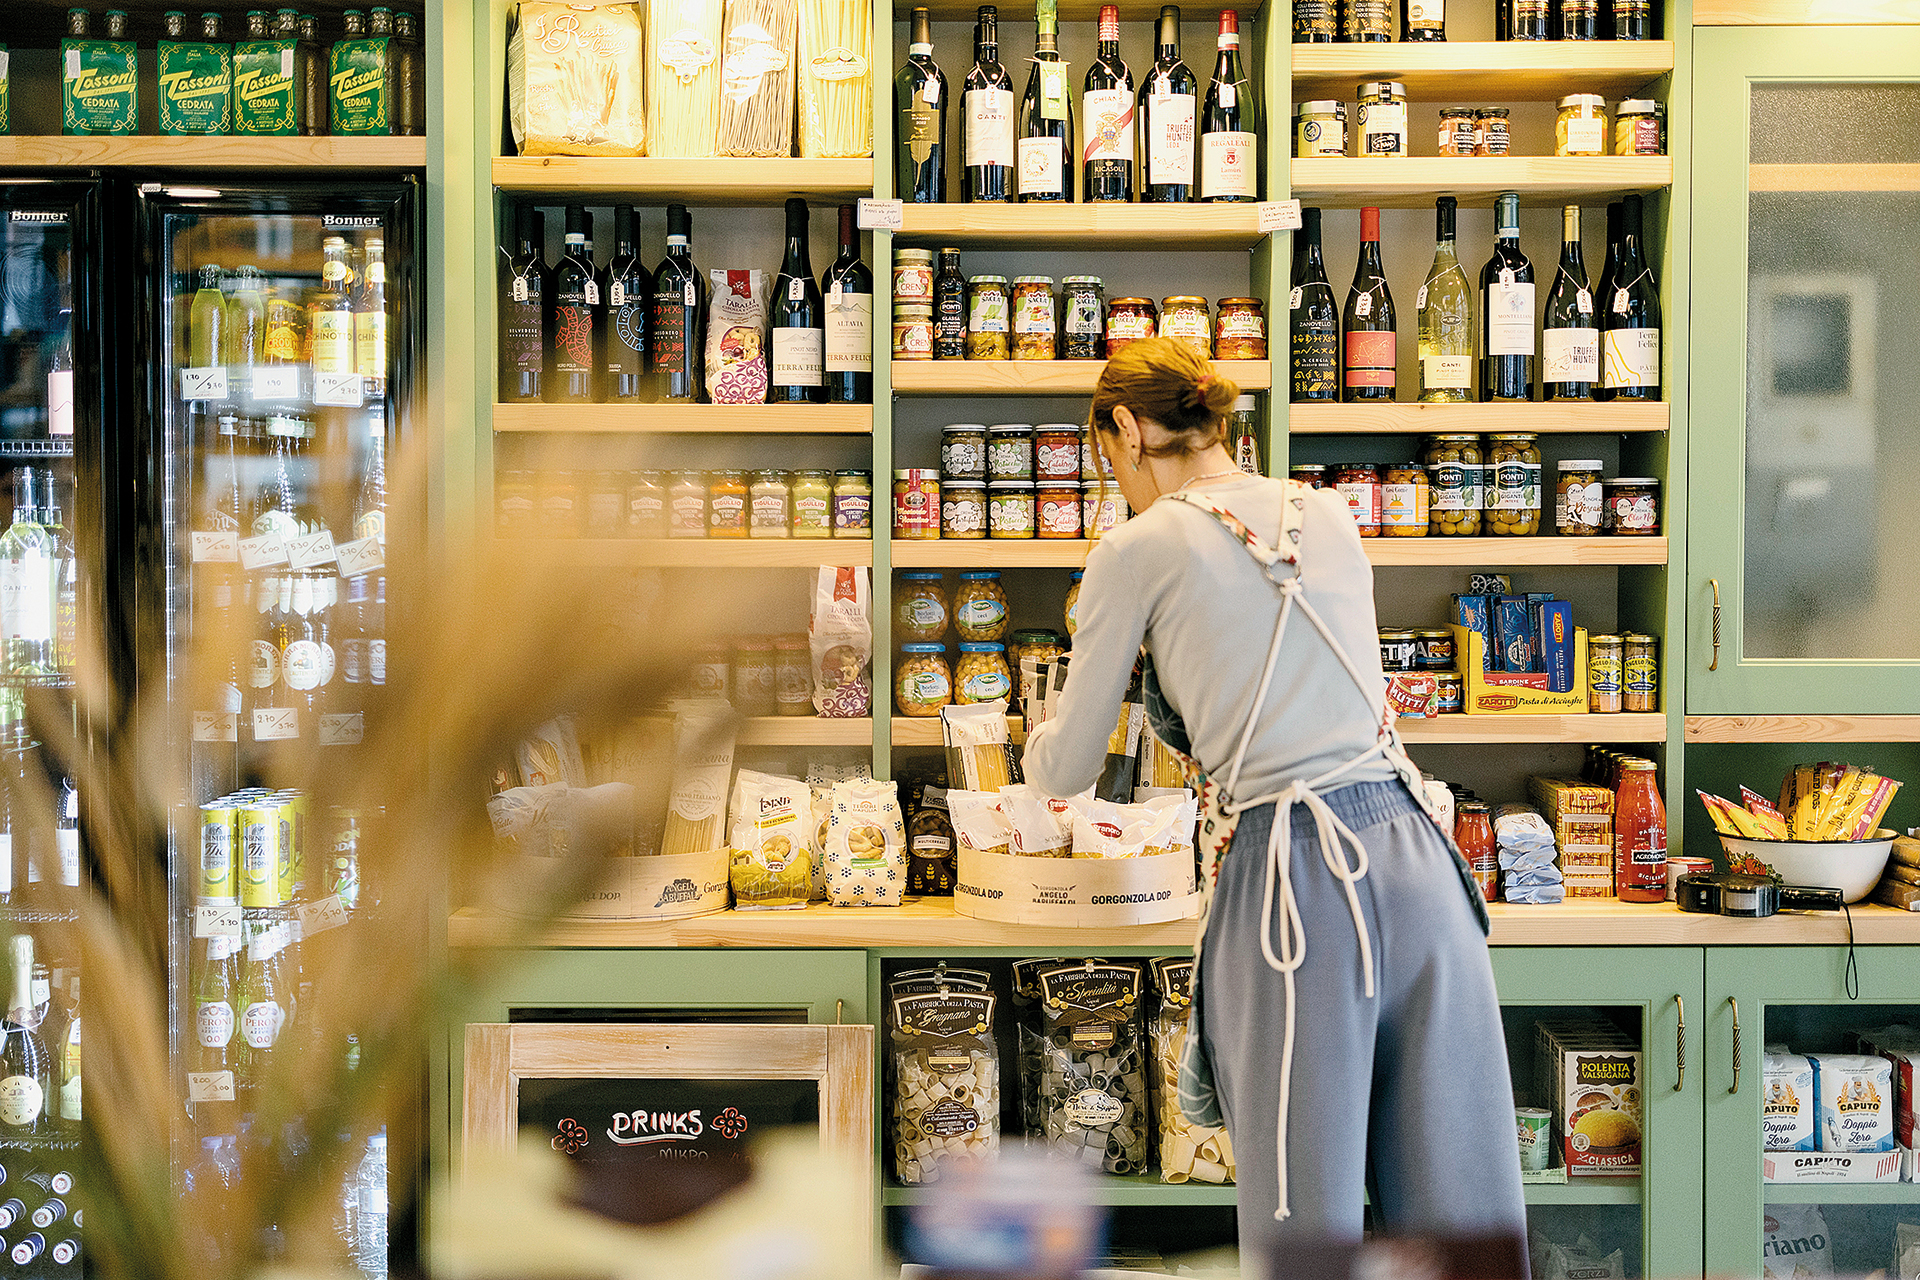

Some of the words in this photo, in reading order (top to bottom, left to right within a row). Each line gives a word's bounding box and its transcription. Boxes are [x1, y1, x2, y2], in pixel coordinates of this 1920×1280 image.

[159, 70, 231, 100] Tassoni
[330, 66, 384, 100] Tassoni
[82, 98, 120, 108] CEDRATA
[177, 99, 214, 110] CEDRATA
[248, 98, 280, 109] CEDRATA
[343, 97, 372, 108] CEDRATA
[977, 113, 1008, 121] CANTI
[1166, 124, 1193, 133] TRUFFLE
[1166, 133, 1192, 143] HUNTER
[1210, 140, 1251, 148] REGALEALI
[1095, 165, 1125, 173] RICASOLI
[11, 210, 68, 221] Bonner
[323, 215, 380, 226] Bonner
[900, 282, 921, 292] CREN
[725, 297, 756, 309] TARALLI
[837, 320, 864, 328] ALTAVIA
[910, 339, 930, 347] CREN
[827, 354, 848, 362] TERRA
[777, 364, 804, 372] TERRA
[1438, 473, 1463, 482] PONTI
[1500, 474, 1524, 482] PONTI
[713, 501, 742, 509] TIGULLIO
[753, 501, 782, 509] TIGULLIO
[797, 501, 825, 509] TIGULLIO
[841, 501, 869, 509] TIGULLIO
[830, 604, 861, 616] TARALLI
[1553, 612, 1564, 643] ZAROTTI
[1626, 659, 1645, 667] ANGELO
[1389, 683, 1425, 708] MUTTI
[1477, 697, 1517, 706] ZAROTTI
[1518, 697, 1540, 706] Pasta
[1540, 695, 1549, 705] di
[1548, 695, 1584, 708] Acciughe
[1742, 790, 1771, 808] MUTTI
[987, 888, 1004, 900] DOP
[1039, 891, 1068, 899] ANGELO
[1091, 892, 1155, 905] GORGONZOLA
[1156, 890, 1172, 901] DOP
[201, 909, 218, 918] 1.30
[1058, 972, 1092, 982] FABBRICA
[1109, 970, 1132, 981] PASTA
[1066, 981, 1118, 1003] Specialità
[904, 1004, 912, 1012] LA
[912, 1000, 946, 1010] FABBRICA
[963, 998, 985, 1009] PASTA
[198, 1017, 232, 1026] PERONI
[917, 1008, 971, 1027] Gragnano
[1581, 1062, 1631, 1072] POLENTA
[1581, 1071, 1631, 1079] VALSUGANA
[1629, 1092, 1635, 1100] 8
[1840, 1102, 1880, 1112] CAPUTO
[612, 1109, 704, 1136] DRINKS
[1763, 1120, 1798, 1134] Doppio
[1841, 1118, 1879, 1133] Doppio
[1766, 1133, 1791, 1147] Zero
[1848, 1131, 1872, 1145] Zero
[1588, 1153, 1635, 1167] CLASSICA
